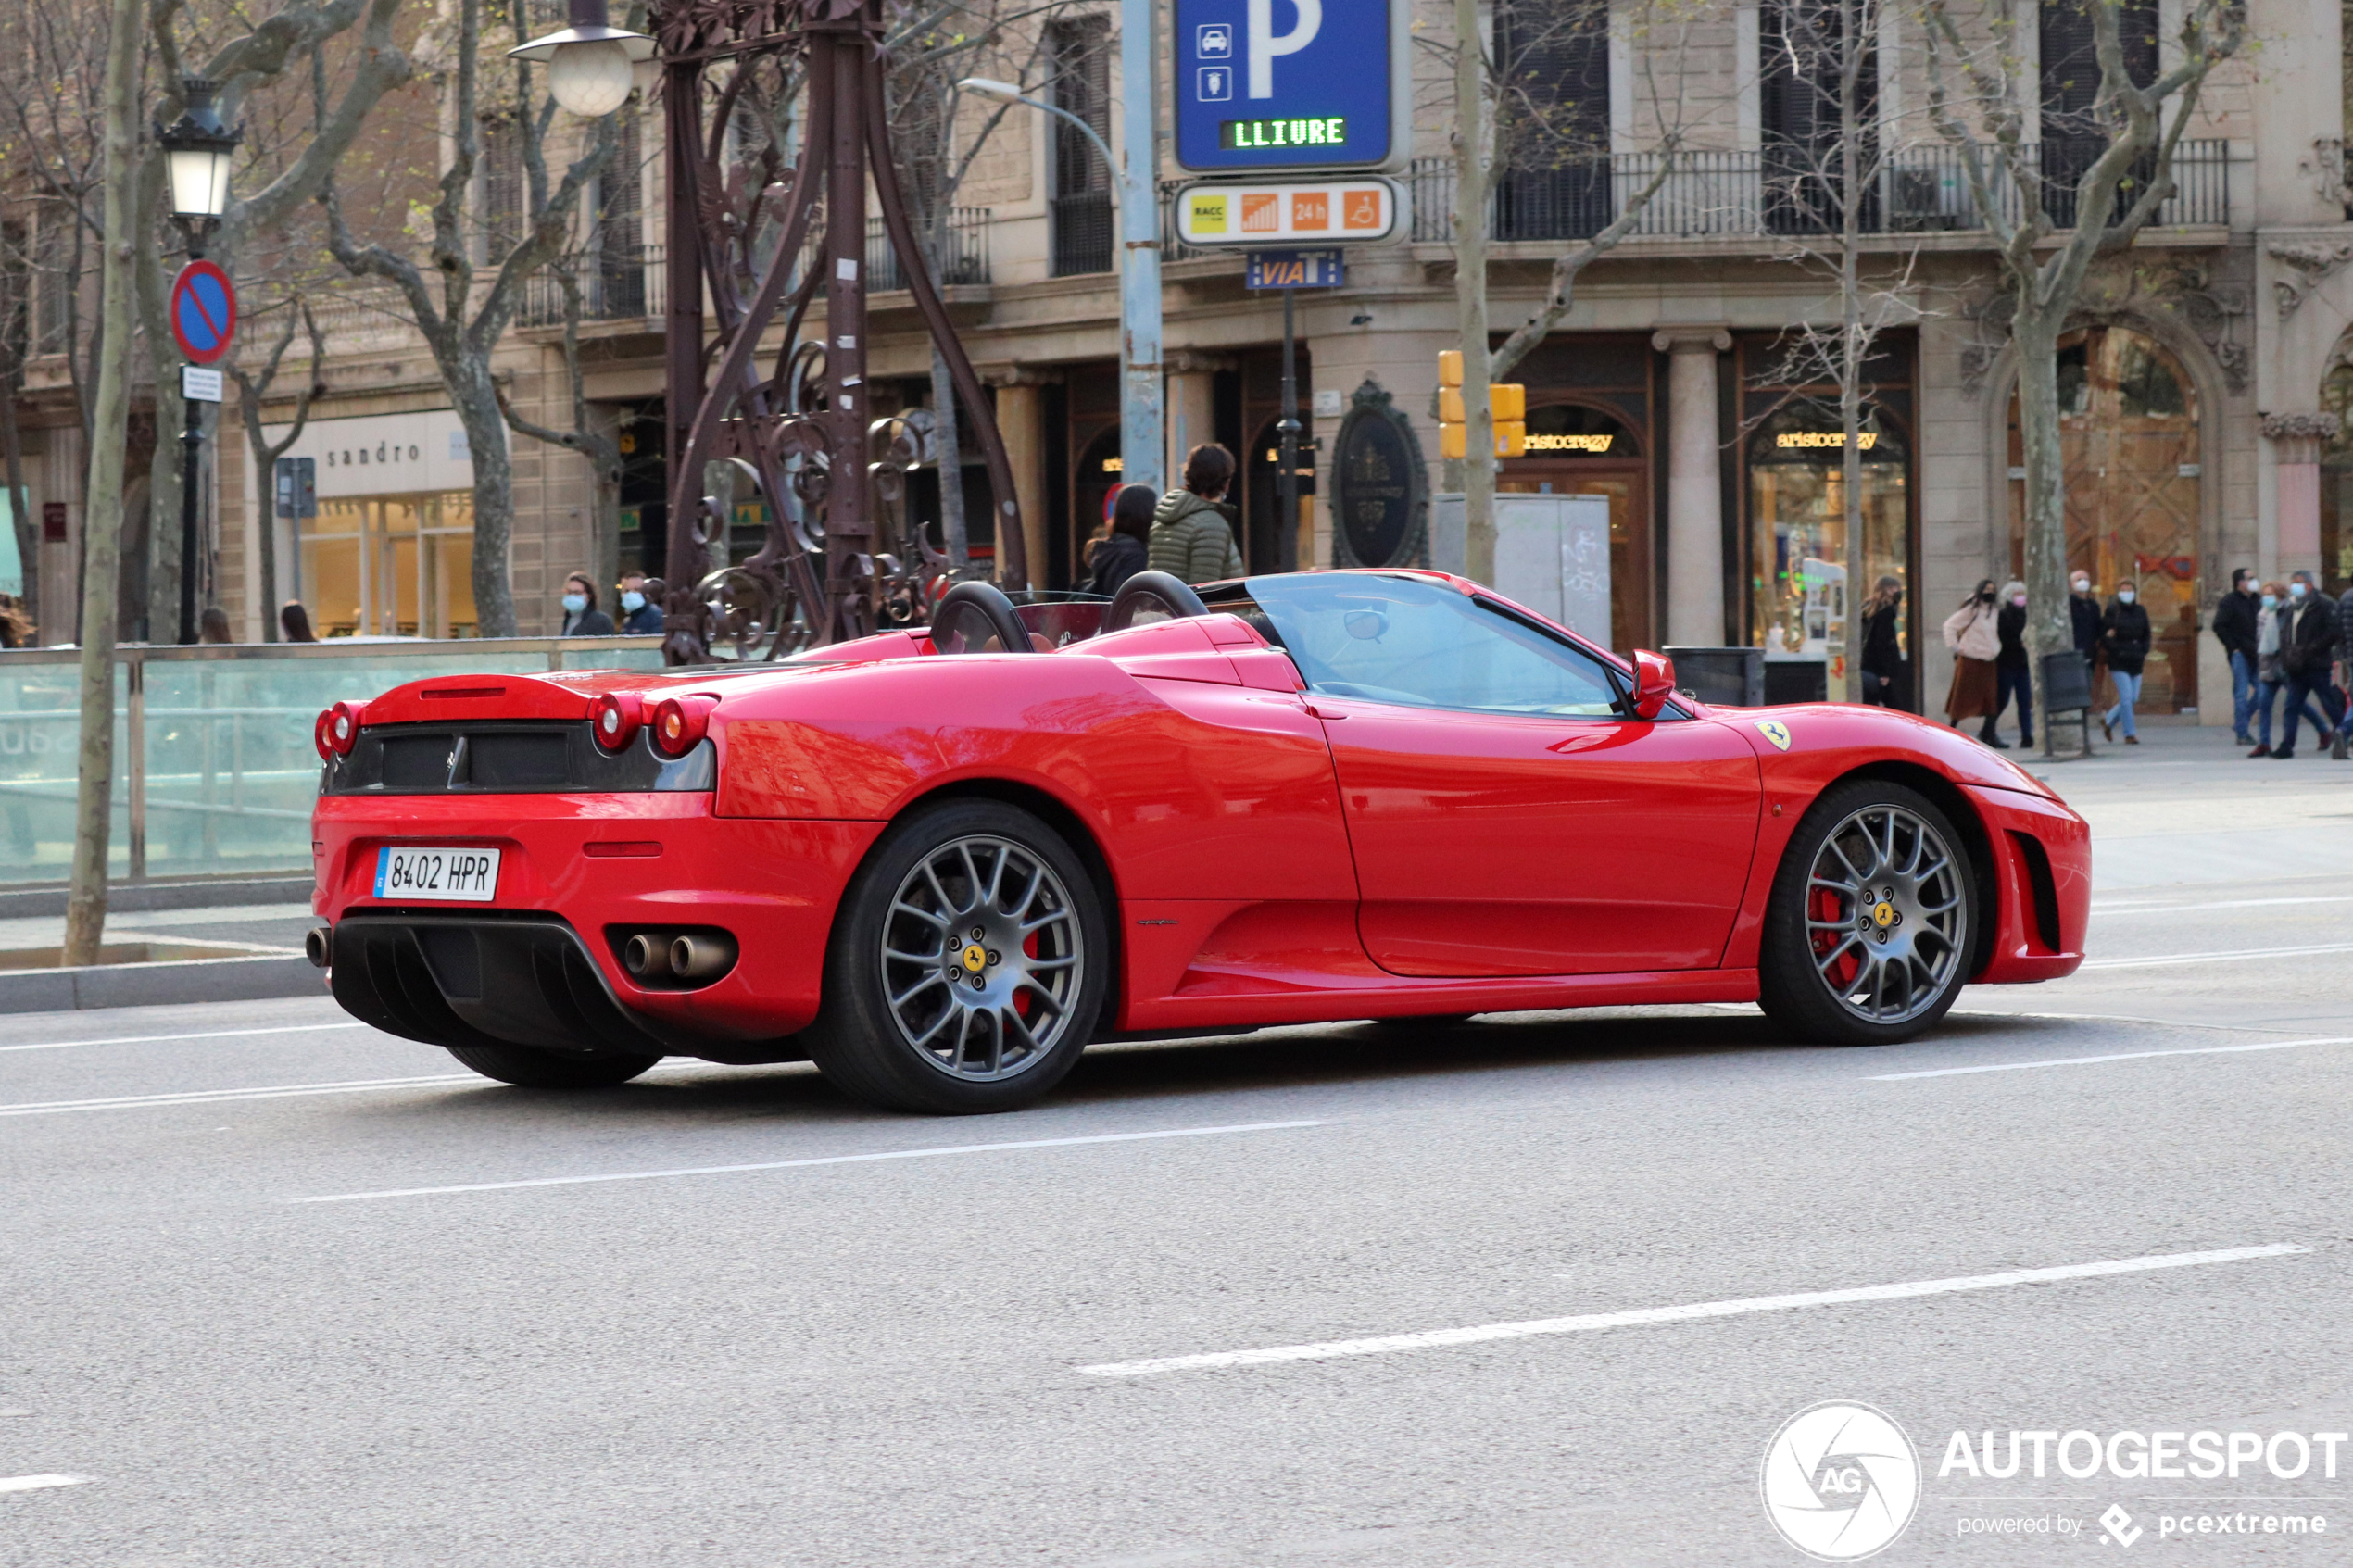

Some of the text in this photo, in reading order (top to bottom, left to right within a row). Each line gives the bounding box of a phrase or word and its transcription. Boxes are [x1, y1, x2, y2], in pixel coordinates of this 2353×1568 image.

[1248, 0, 1322, 99] P
[1235, 118, 1344, 146] LLIURE
[1195, 207, 1223, 216] RACC
[1296, 202, 1326, 220] 24 h
[1523, 433, 1613, 452] ristocrazy
[1777, 432, 1878, 450] aristocrzy
[328, 441, 419, 467] sandro
[392, 855, 489, 891] 8402 HPR
